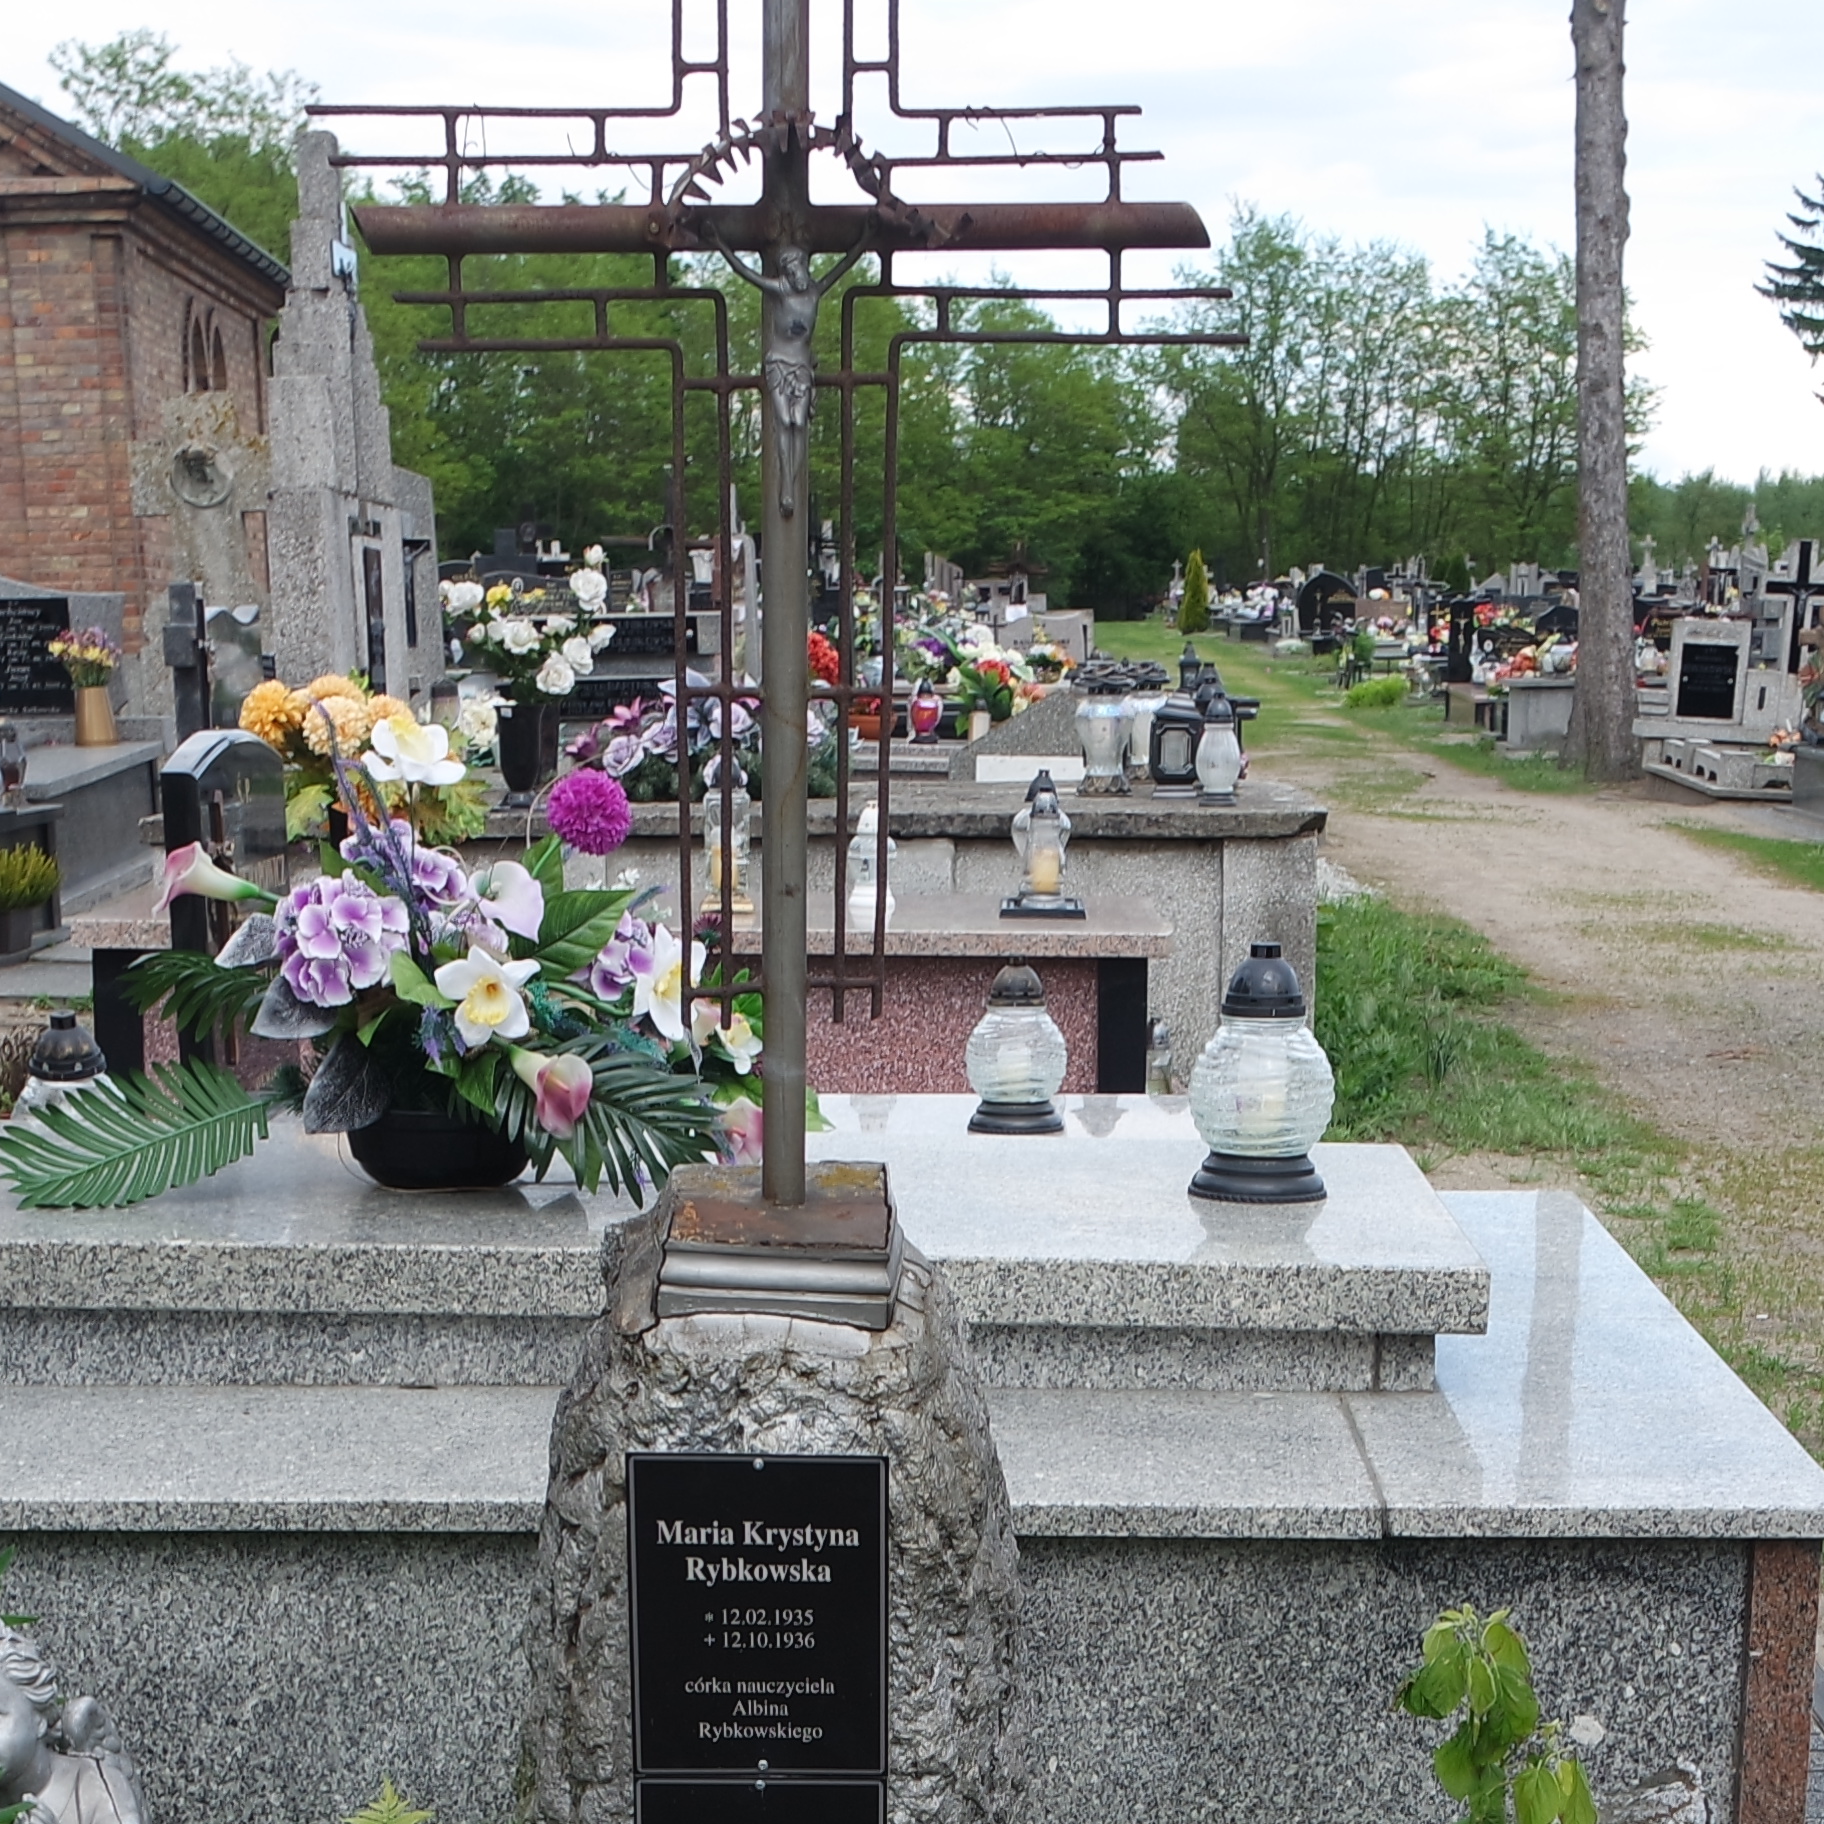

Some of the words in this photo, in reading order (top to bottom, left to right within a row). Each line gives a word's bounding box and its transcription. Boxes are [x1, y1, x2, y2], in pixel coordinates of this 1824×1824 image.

[656, 1520, 735, 1546] Maria
[742, 1520, 860, 1552] Krystyna
[685, 1556, 832, 1587] Rybkowska
[722, 1608, 814, 1627] 12.02.1935
[723, 1631, 816, 1649] 12.10.1936
[684, 1676, 732, 1695] córka
[736, 1677, 836, 1698] nauczyciela
[732, 1699, 789, 1717] Albina
[698, 1721, 824, 1743] Rybkowskiego
